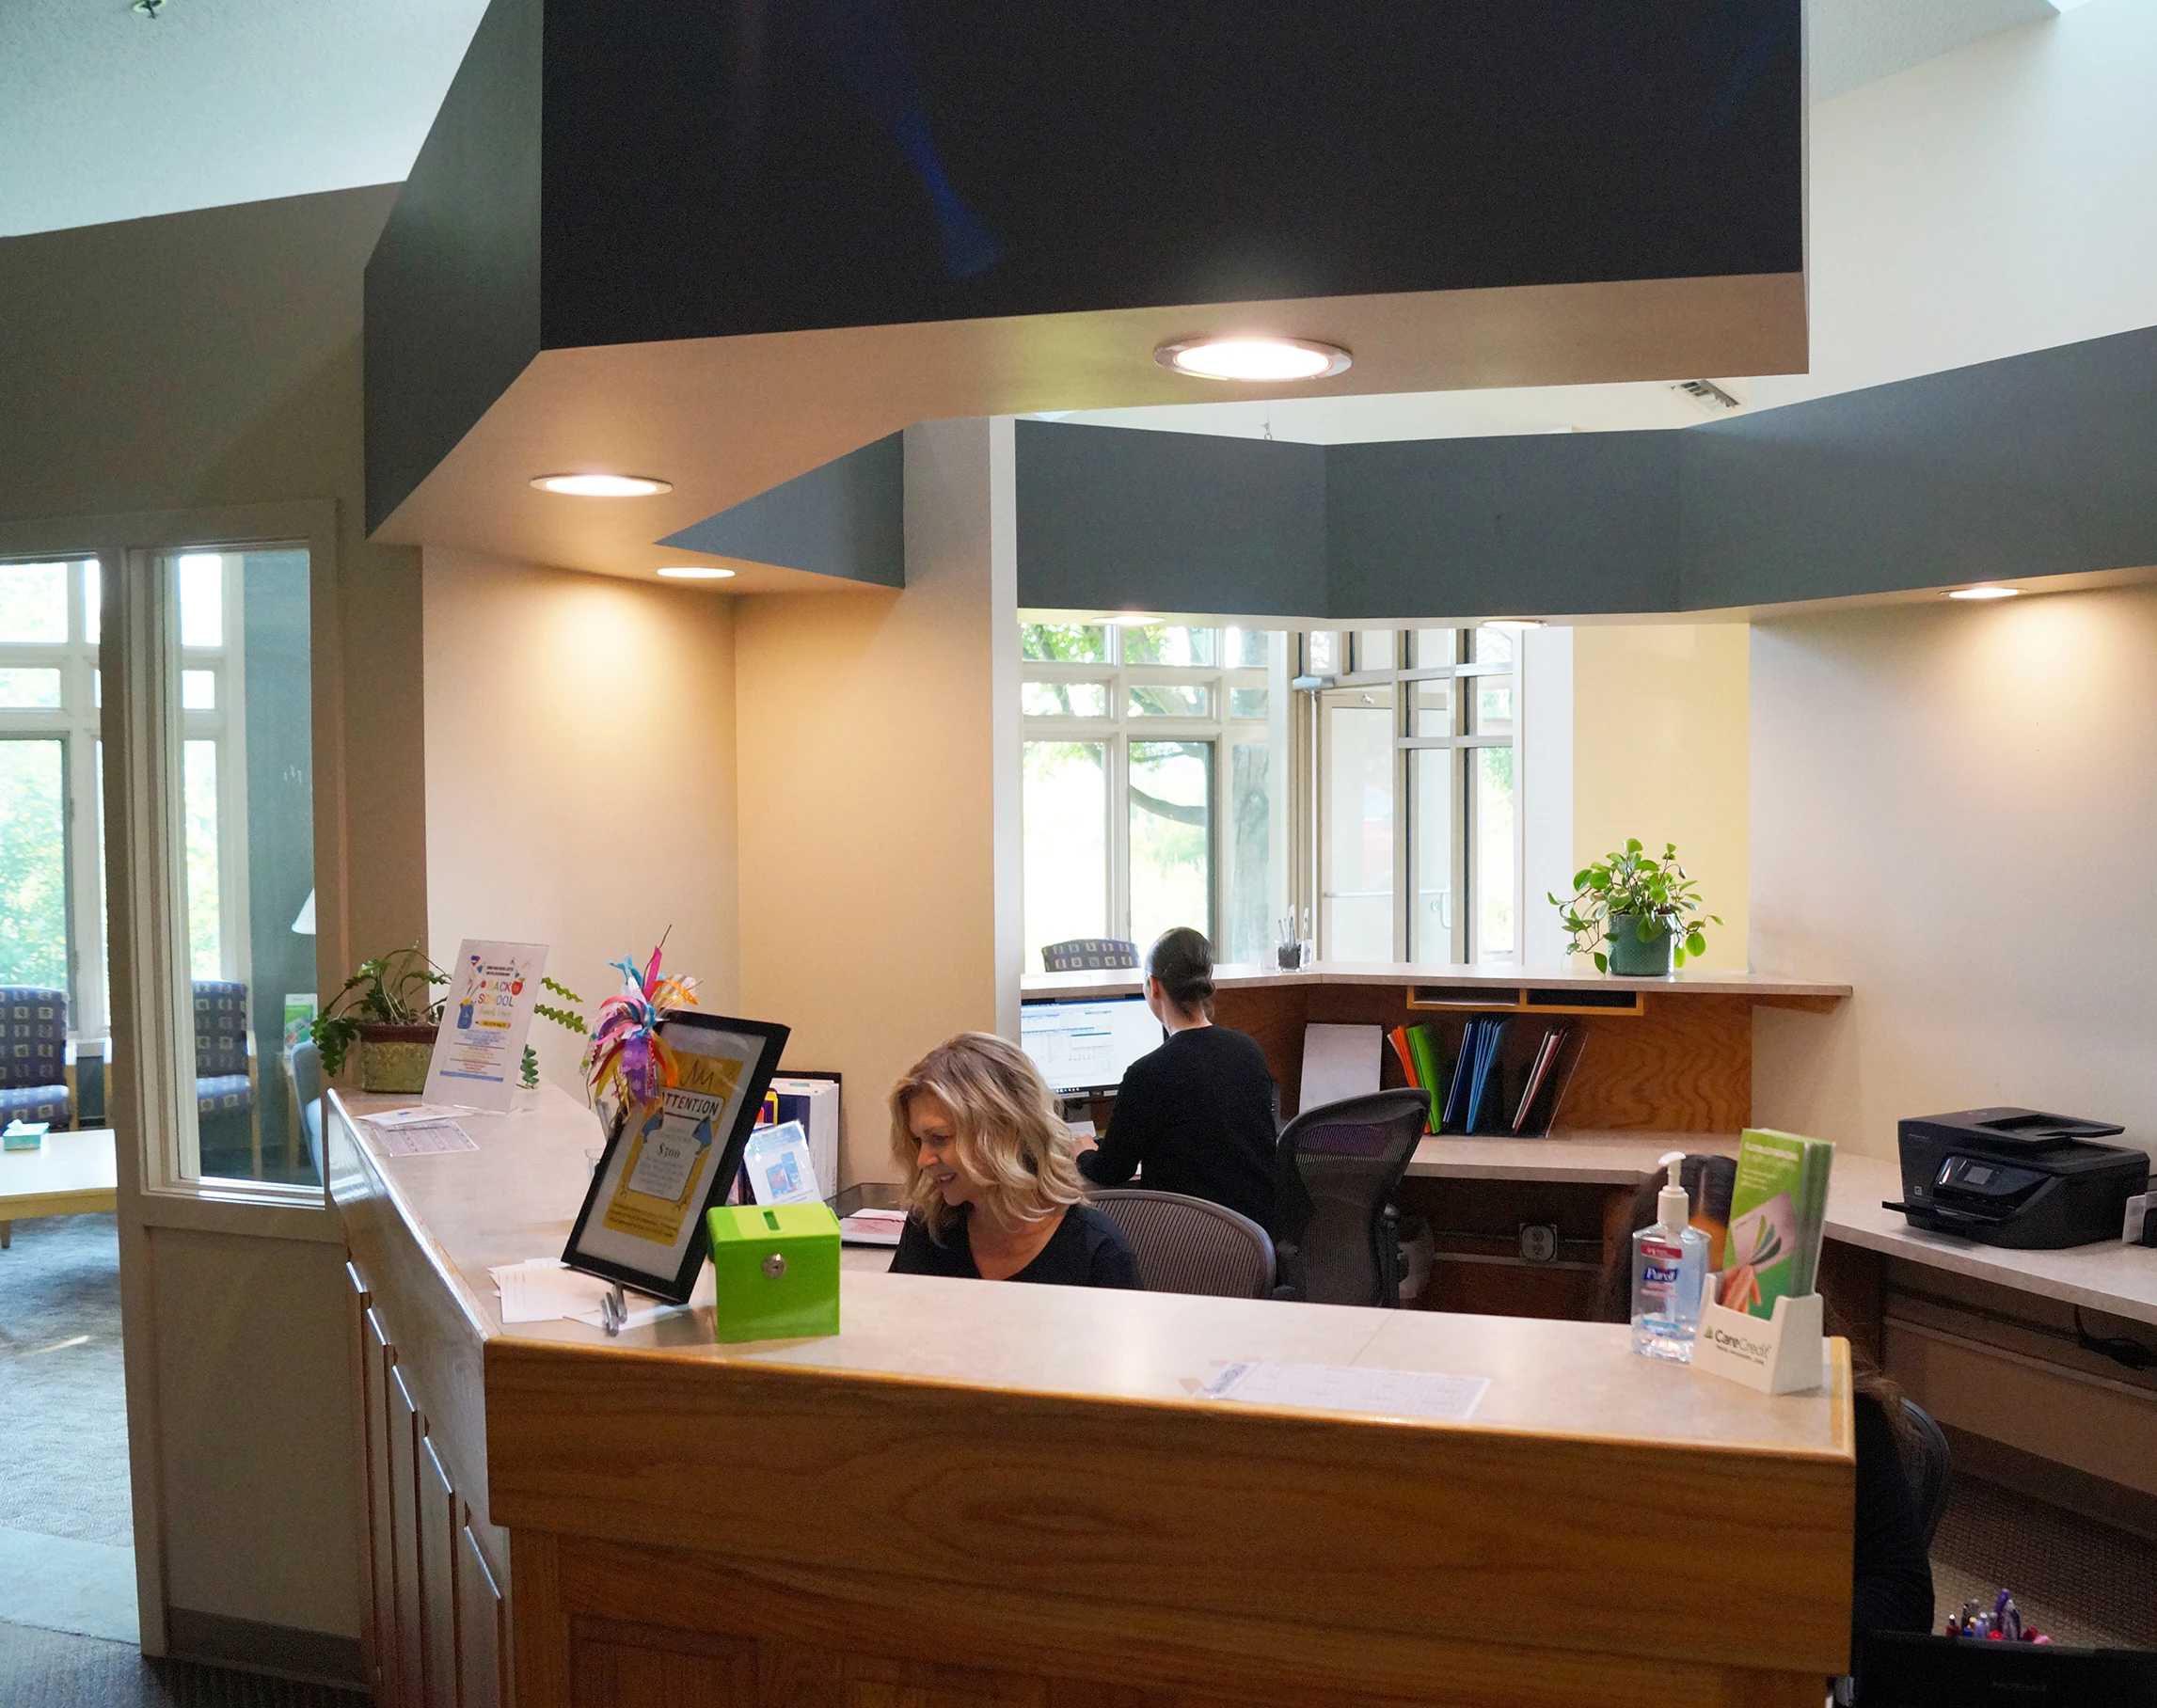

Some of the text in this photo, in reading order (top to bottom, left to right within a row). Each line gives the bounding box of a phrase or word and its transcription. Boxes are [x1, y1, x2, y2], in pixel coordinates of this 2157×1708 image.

[486, 980, 512, 992] BACK
[478, 993, 514, 1007] SCHOOL
[1715, 1329, 1770, 1359] CareCredit
